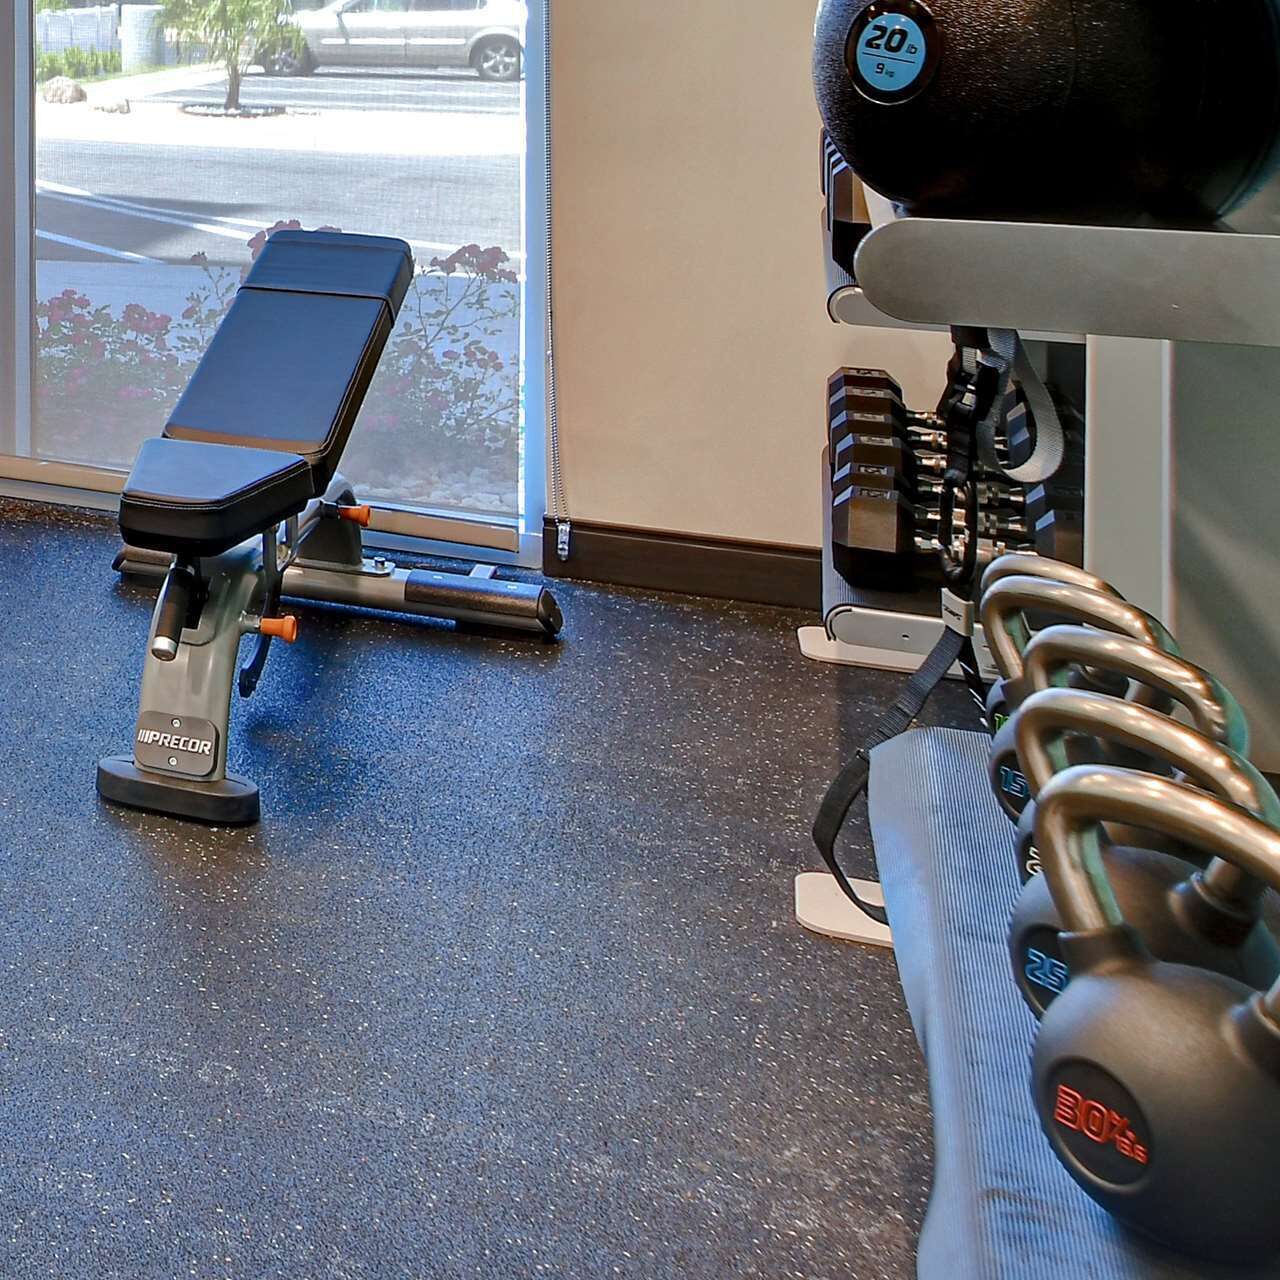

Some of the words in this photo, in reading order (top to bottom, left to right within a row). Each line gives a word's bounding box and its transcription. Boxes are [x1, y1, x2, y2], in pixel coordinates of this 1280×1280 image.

[865, 24, 908, 52] 20
[875, 63, 885, 74] 9
[143, 730, 212, 755] PRECOR
[1024, 948, 1069, 993] 25
